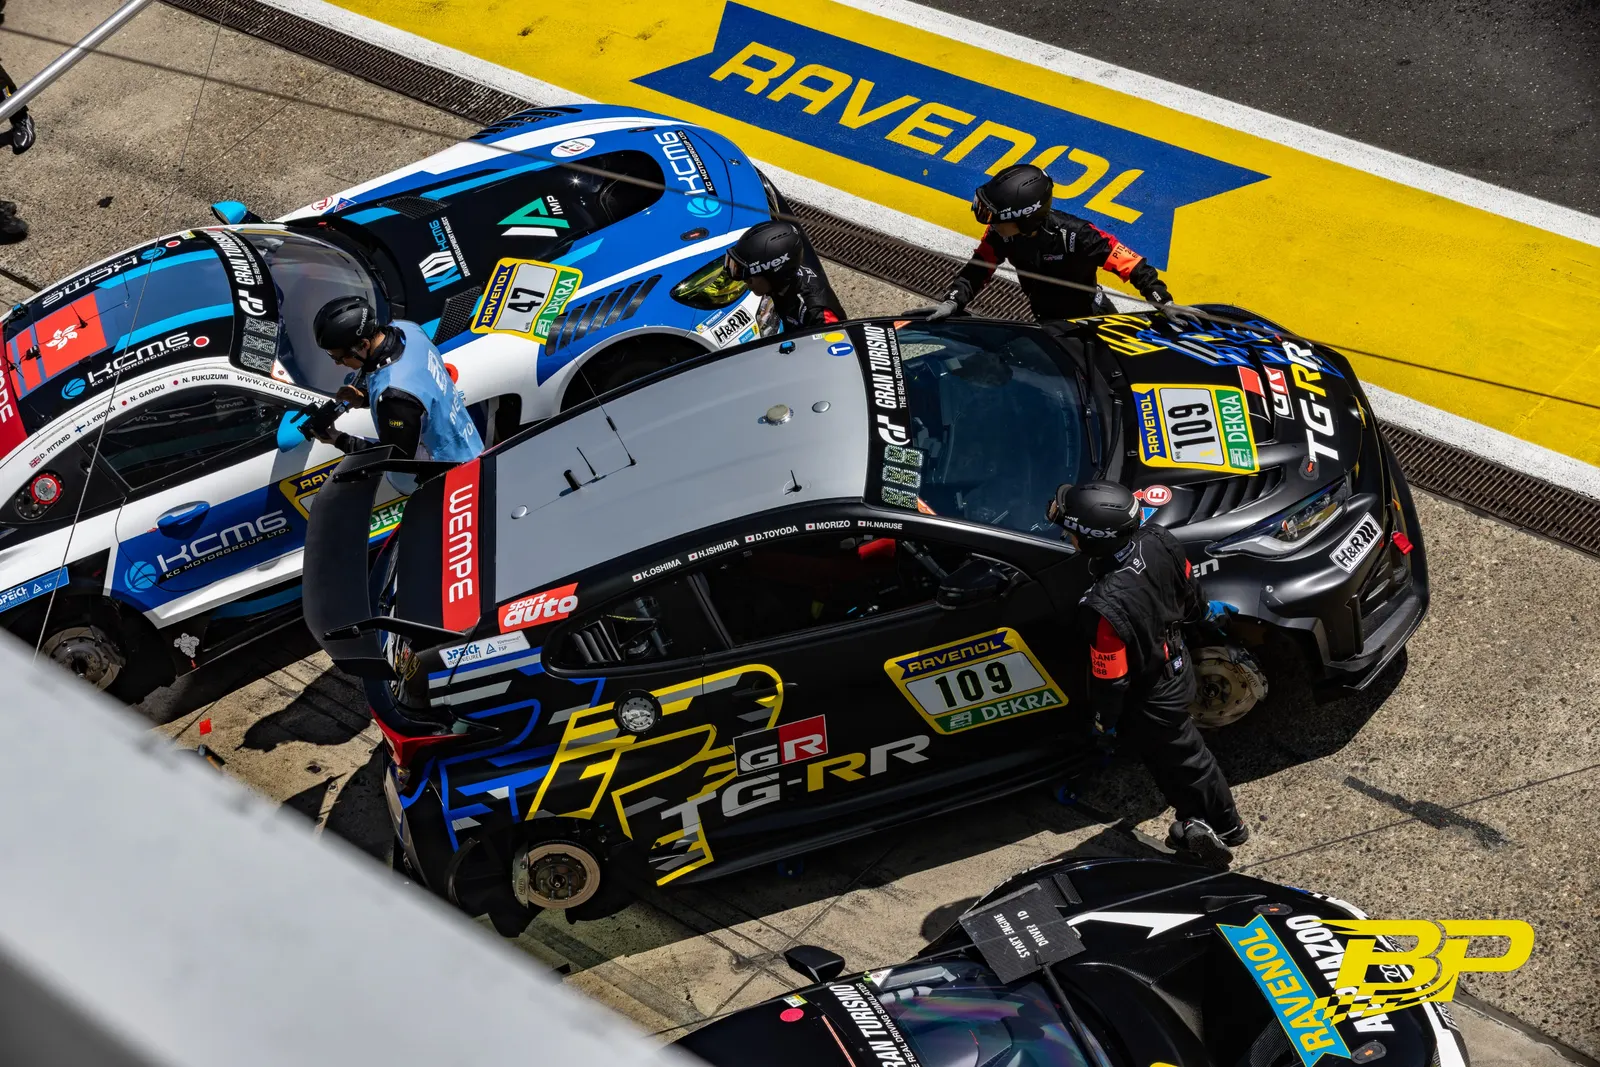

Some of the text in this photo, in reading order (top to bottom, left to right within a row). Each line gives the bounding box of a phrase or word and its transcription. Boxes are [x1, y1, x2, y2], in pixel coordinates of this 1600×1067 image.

[708, 40, 1146, 224] RAVENOL
[654, 131, 706, 197] KCMG
[1000, 200, 1042, 220] uvex
[429, 219, 449, 252] KCMG
[229, 258, 256, 286] GRAN
[749, 252, 791, 275] uvex
[481, 268, 511, 324] RAVENOL
[507, 287, 546, 313] 47
[544, 277, 577, 315] DEKRA
[714, 316, 740, 343] H&R
[88, 332, 191, 383] KCMG
[863, 323, 897, 410] GRAN TURISMO
[887, 327, 908, 409] THE REAL DRIVING SIMULATOR
[91, 377, 104, 387] KC
[138, 383, 166, 399] GAMOU
[191, 374, 229, 382] FUKUZUMI
[92, 405, 116, 423] KROHN
[1219, 394, 1248, 443] DEKRA
[1282, 341, 1340, 463] TG-RR
[1140, 394, 1161, 454] RAVENOL
[1167, 402, 1216, 450] 109
[46, 433, 71, 455] PITTARD
[370, 500, 407, 532] DEK
[816, 520, 851, 530] MORIZO
[866, 521, 903, 530] H.NARUSE
[1063, 519, 1118, 539] uvex
[157, 510, 287, 572] KCMG
[448, 483, 474, 604] WEMPE
[698, 539, 739, 559] H.ISHIURA
[755, 525, 799, 541] D.TOYODA
[166, 527, 291, 579] KC MOTORGROUP LTD.
[641, 558, 682, 578] K.OSHIMA
[1335, 535, 1365, 568] H&R
[503, 595, 579, 628] auto
[507, 593, 548, 612] sport
[448, 654, 478, 666] INGNIEURE
[907, 639, 1002, 673] RAVENOL
[934, 661, 1013, 709] 109
[981, 691, 1059, 721] DEKRA
[739, 733, 825, 772] GR
[660, 734, 931, 837] TG-RR
[993, 912, 1032, 960] START ENGINE
[855, 982, 886, 1015] SIMULATOR
[1238, 928, 1336, 1053] RAVENOL
[828, 984, 888, 1038] TURISMO
[881, 1014, 904, 1043] DRIVING
[898, 1043, 917, 1063] REAL
